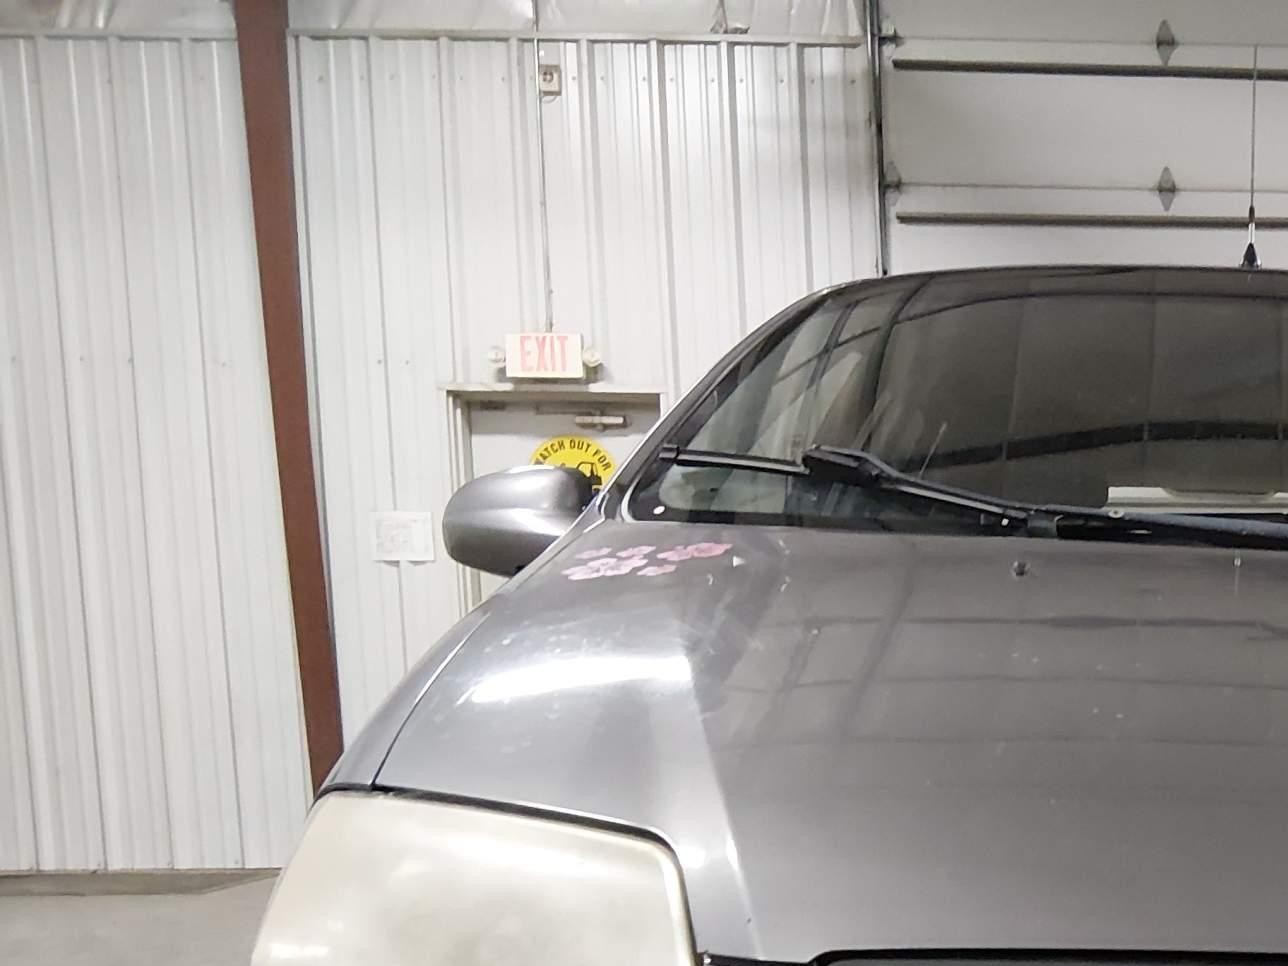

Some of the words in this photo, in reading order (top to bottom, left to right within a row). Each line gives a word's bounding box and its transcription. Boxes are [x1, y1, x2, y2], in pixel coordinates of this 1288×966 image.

[519, 335, 569, 372] EXIT
[569, 438, 592, 453] OUT
[592, 448, 612, 471] FOR
